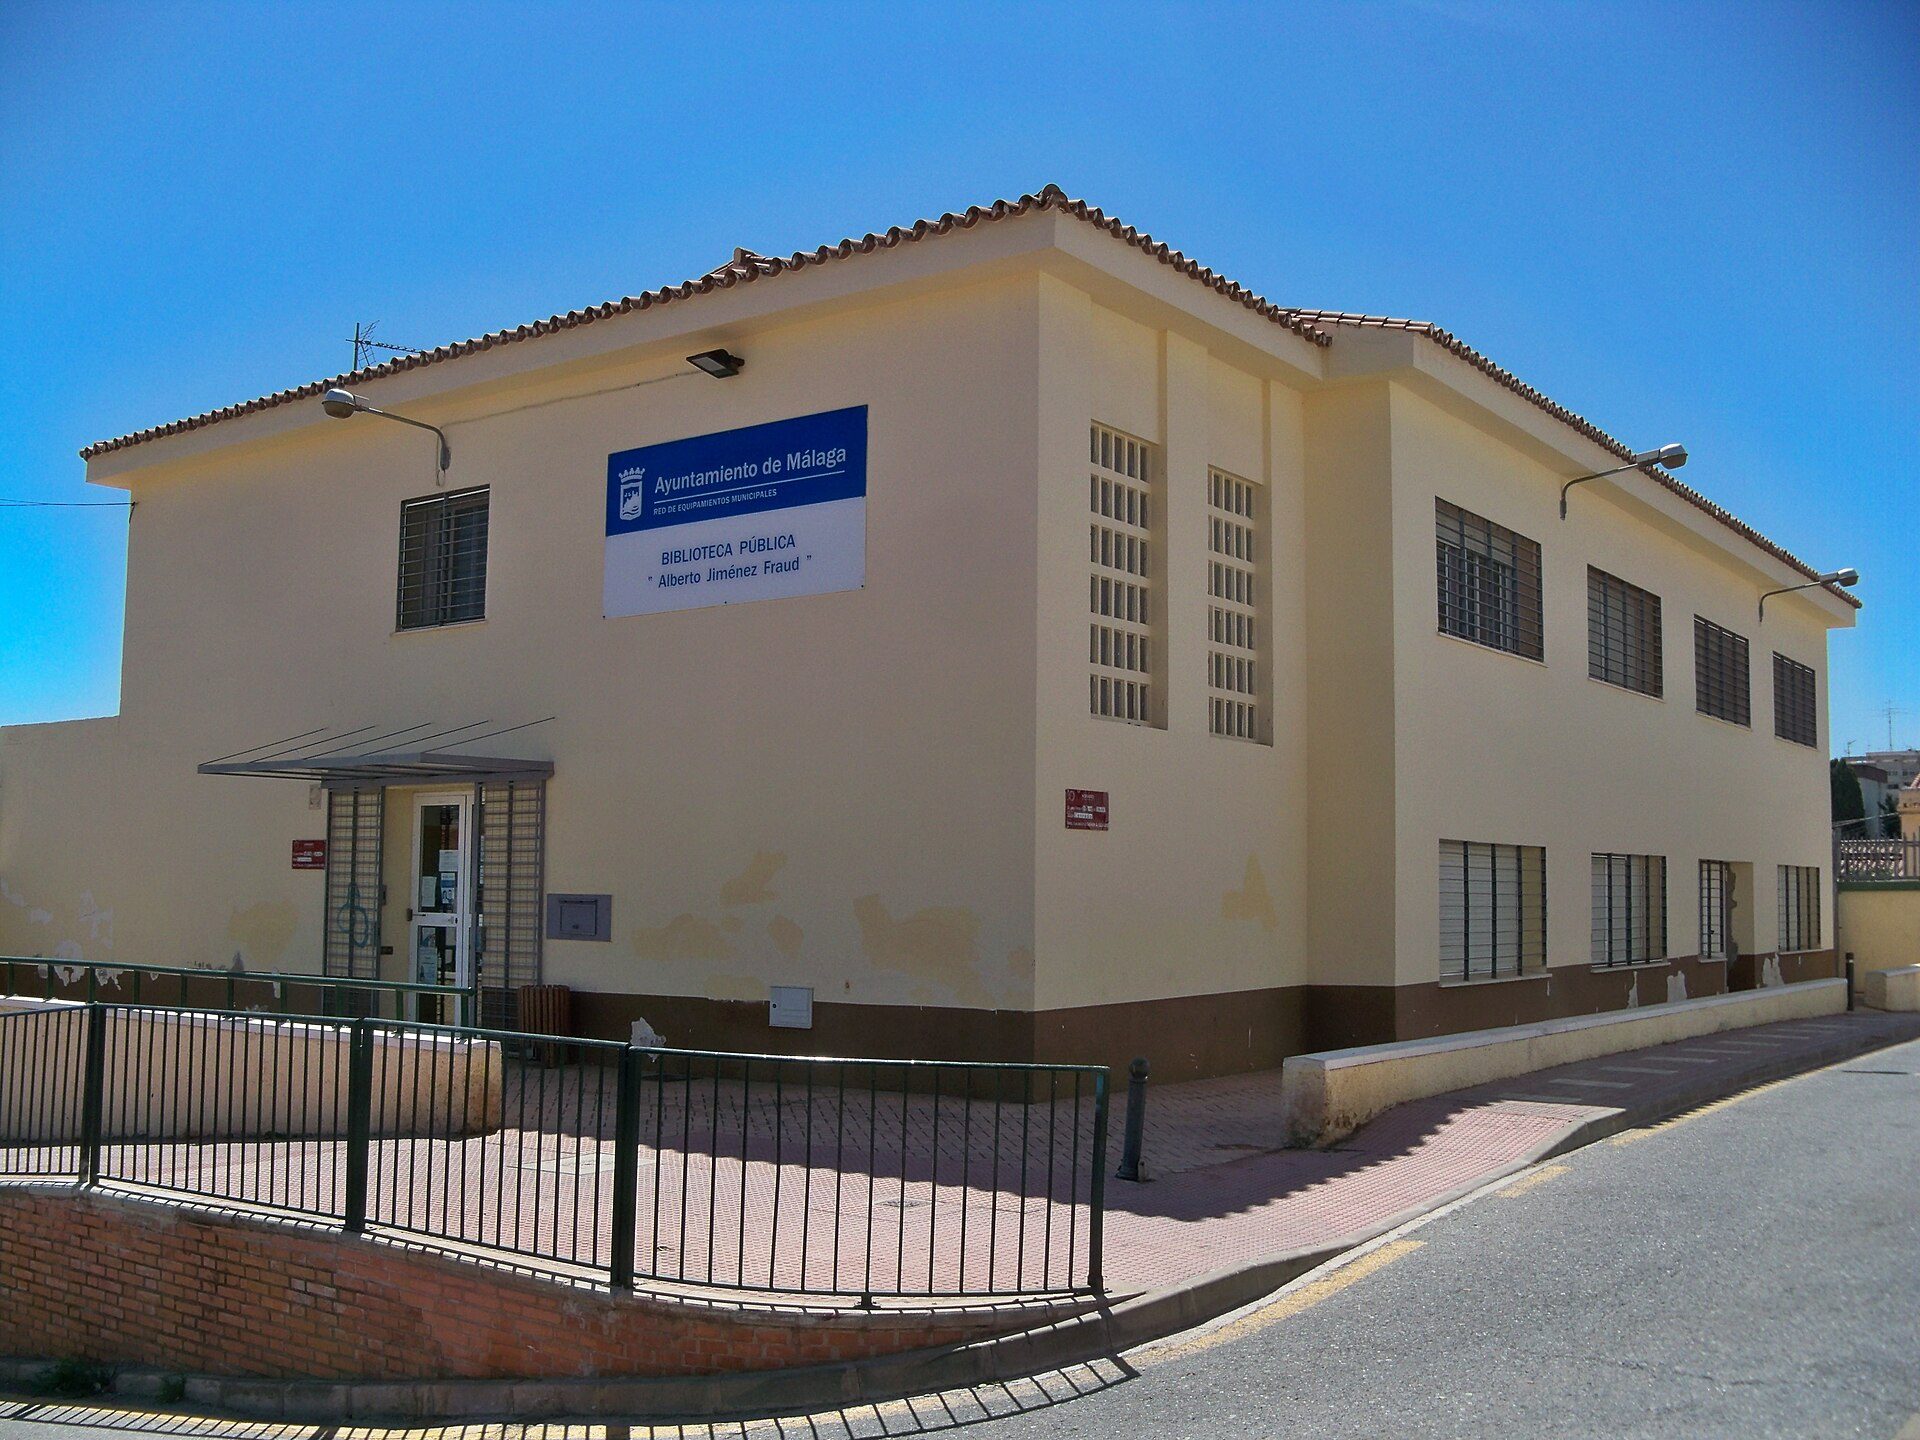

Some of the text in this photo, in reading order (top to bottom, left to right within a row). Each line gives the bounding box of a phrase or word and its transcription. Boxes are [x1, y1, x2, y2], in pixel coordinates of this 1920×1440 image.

[655, 447, 846, 495] Ayuntamiento de Málaga
[653, 488, 777, 515] RED DE EQUIPAMIENTOS MUNICIPALES
[661, 534, 796, 565] BIBLIOTECA PÚBLICA
[658, 570, 701, 588] Alberto
[706, 563, 757, 582] Jiménez
[764, 556, 799, 575] Fraud
